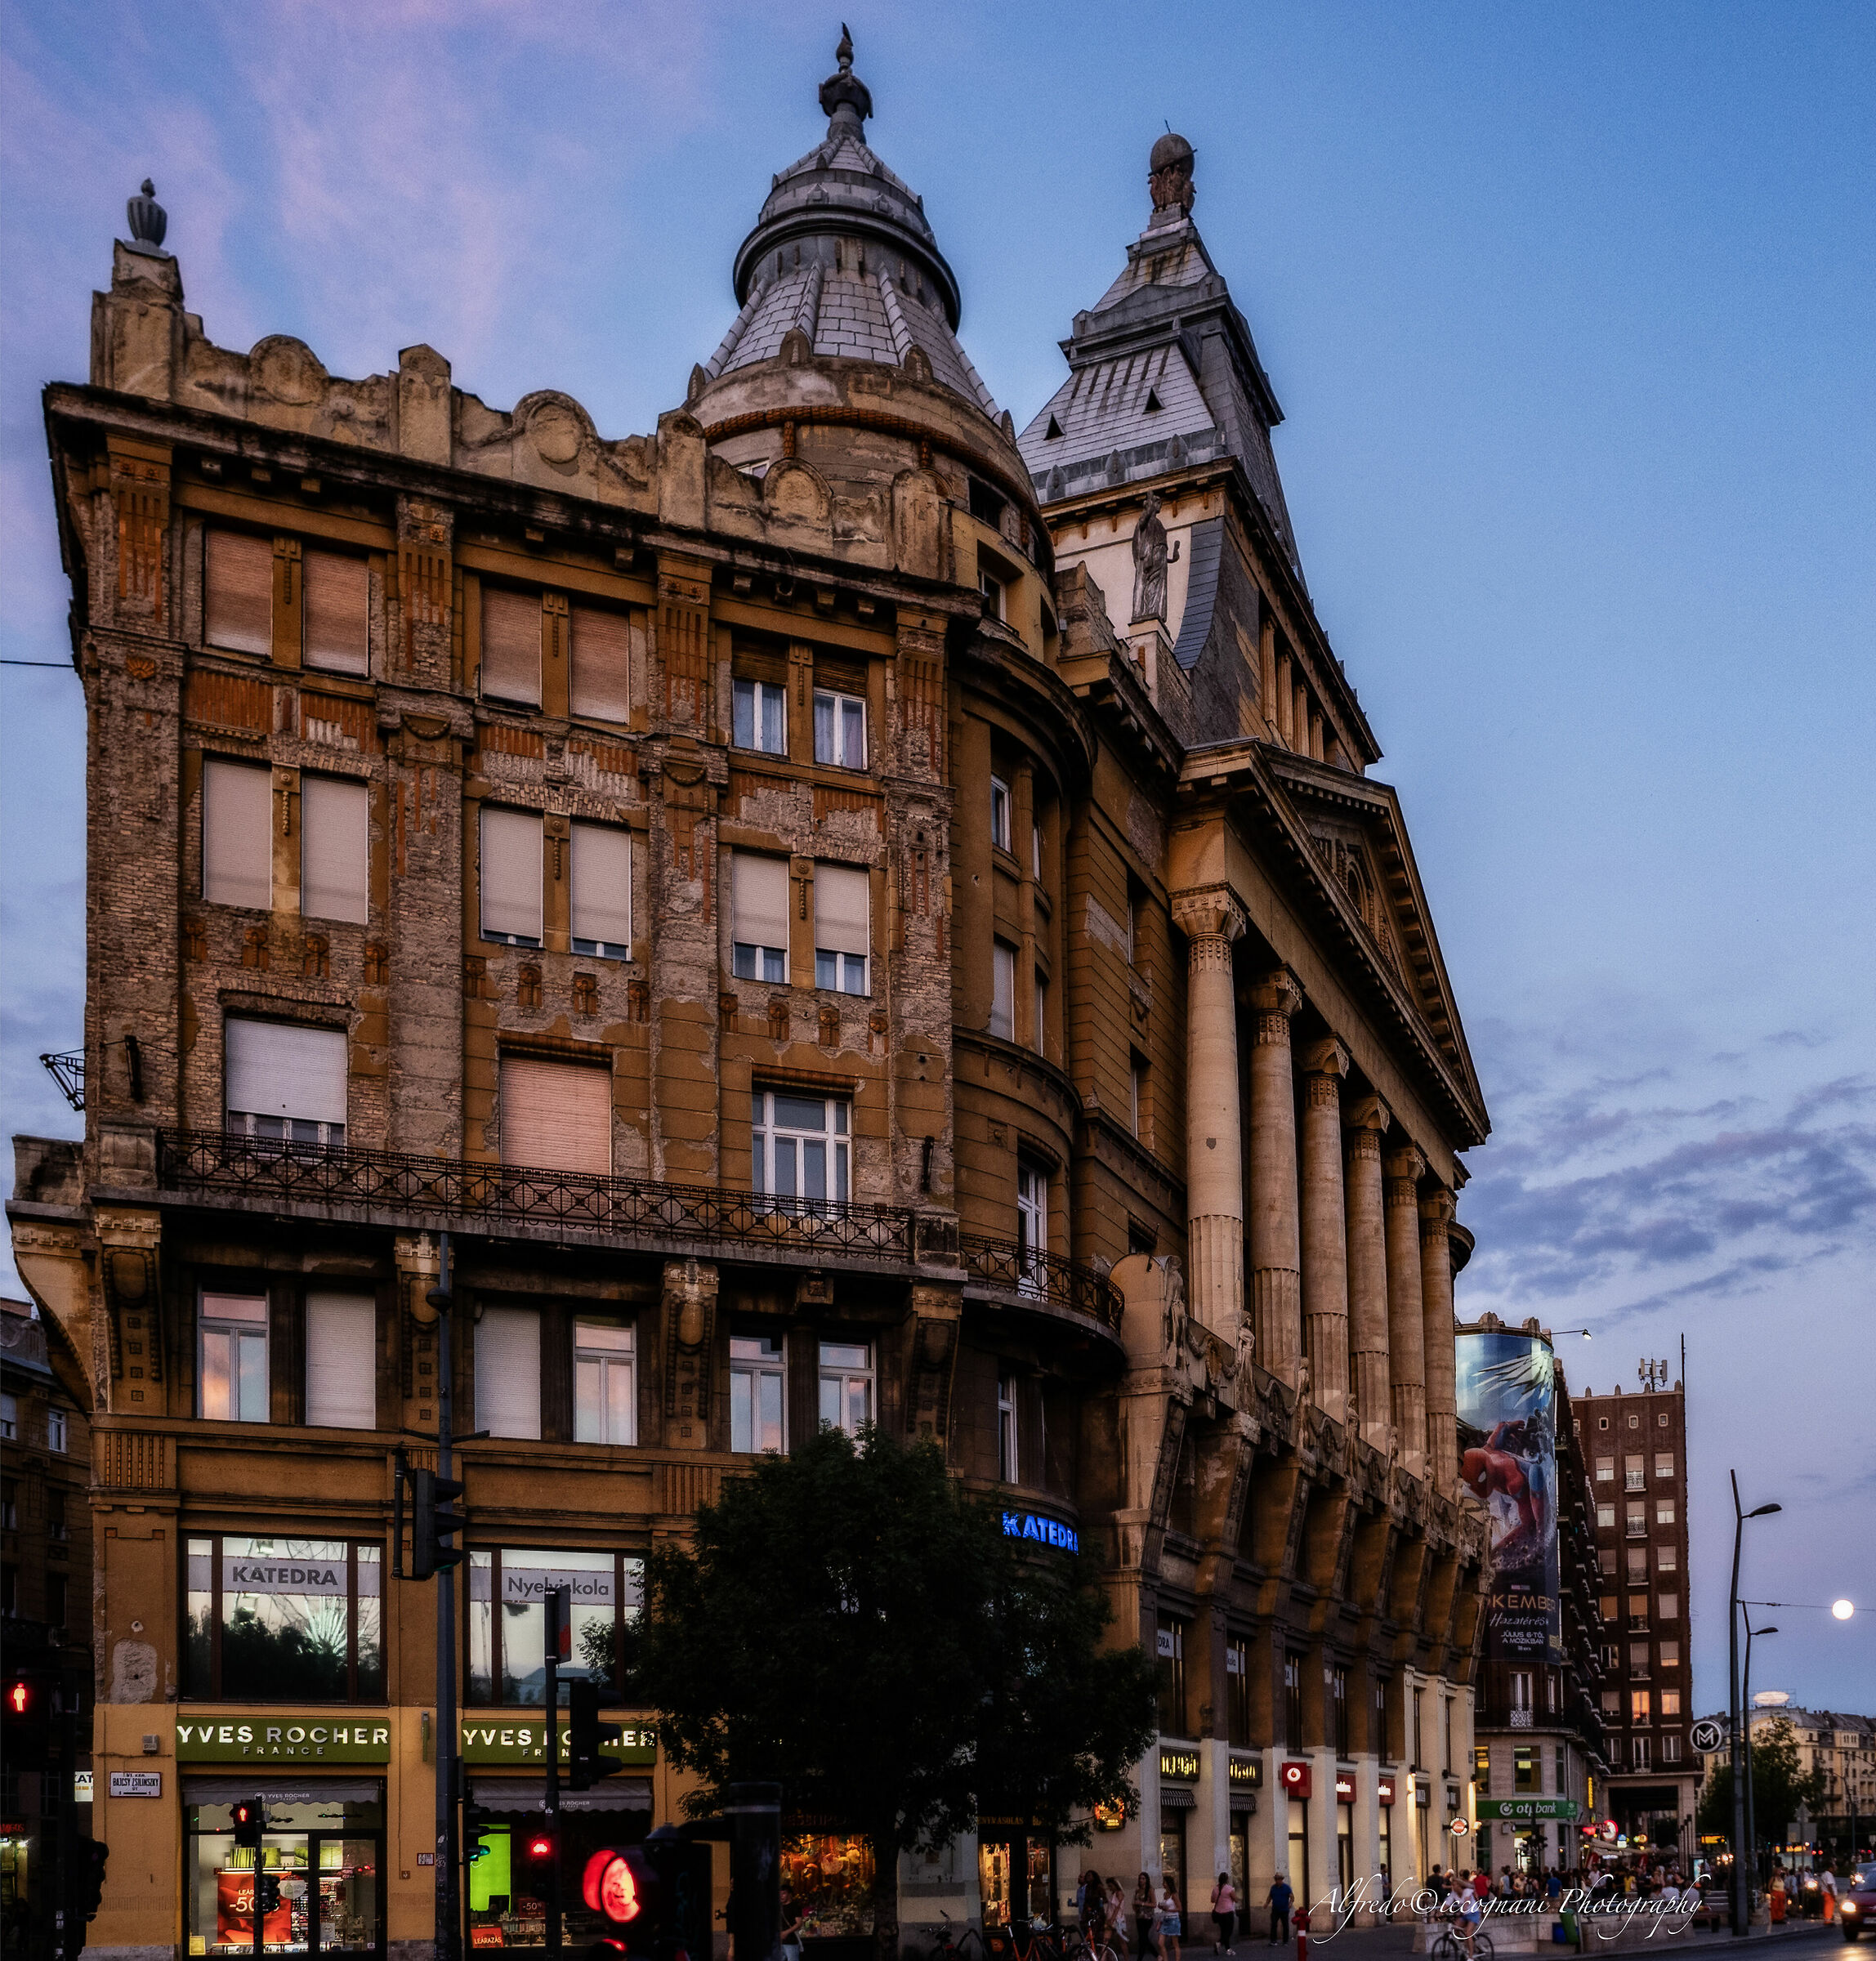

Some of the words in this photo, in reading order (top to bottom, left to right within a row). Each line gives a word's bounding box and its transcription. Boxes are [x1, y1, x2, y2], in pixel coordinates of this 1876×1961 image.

[1002, 1511, 1079, 1556] KATEDRA
[232, 1566, 338, 1586] KATEDRA
[176, 1726, 253, 1744] YVES
[266, 1726, 388, 1744] ROCHER
[462, 1729, 532, 1746] YVES
[243, 1746, 324, 1755] FRANCE
[113, 1778, 131, 1787] BAJCSY
[1535, 1802, 1557, 1814] bank
[474, 1935, 502, 1945] LEÁRAZÁS
